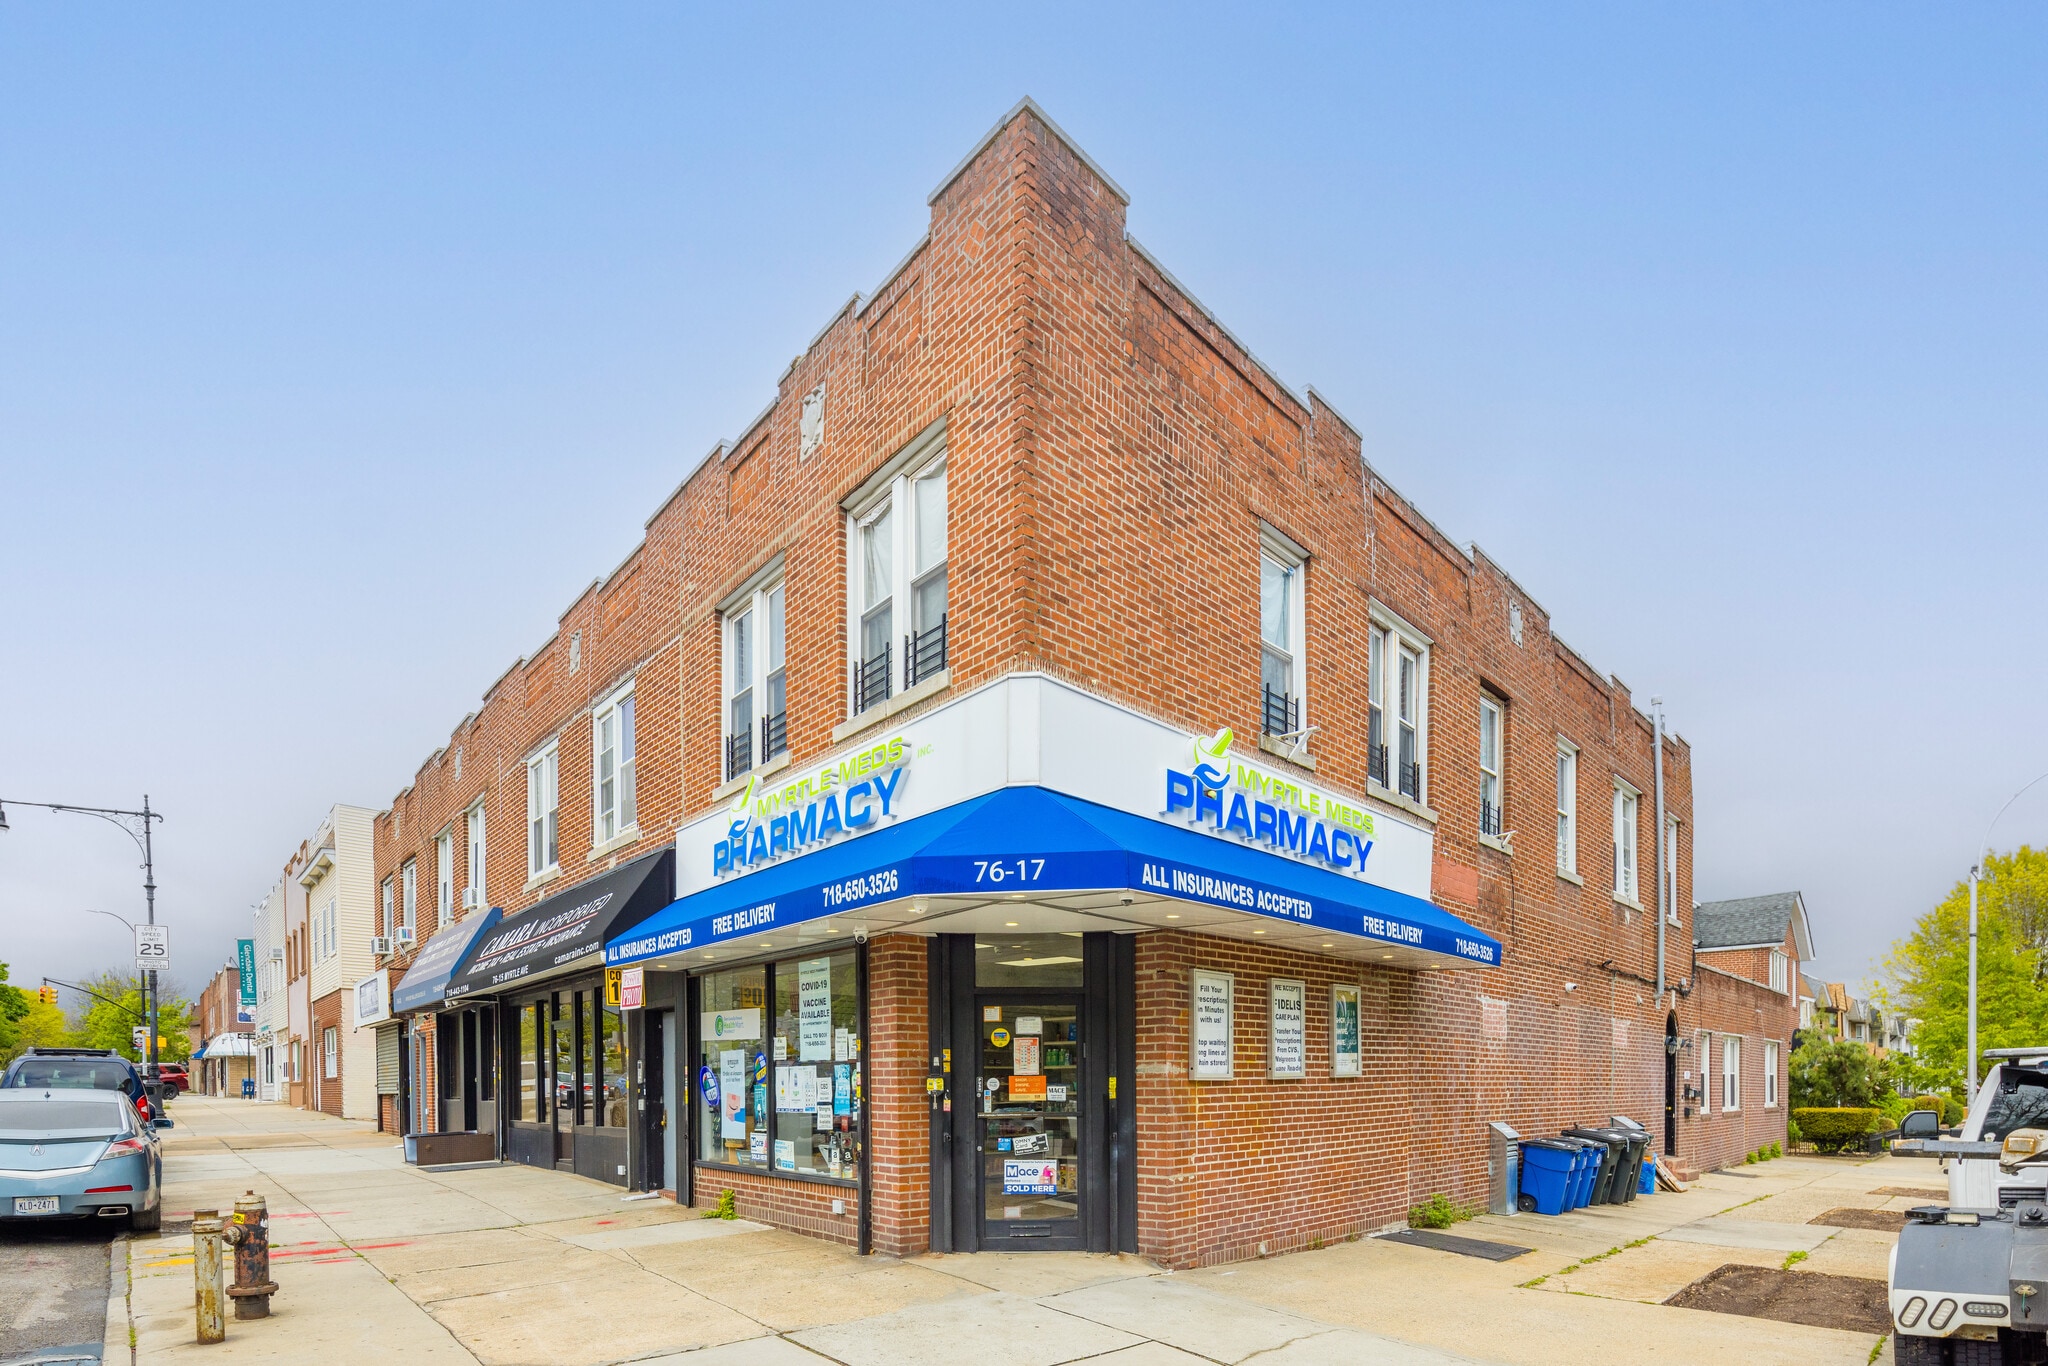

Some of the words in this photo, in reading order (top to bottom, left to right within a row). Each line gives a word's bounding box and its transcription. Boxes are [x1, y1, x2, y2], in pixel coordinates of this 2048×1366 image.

[757, 768, 832, 819] MYRTLE
[838, 737, 903, 784] MEDS
[917, 744, 934, 759] INC.
[1237, 765, 1320, 815] MYRTLE
[1326, 799, 1374, 835] MEDS
[713, 767, 903, 877] PHARMACY
[1166, 768, 1374, 873] PHARMACY
[974, 859, 1045, 882] 76-17
[822, 869, 898, 908] 718-650-3526
[1142, 863, 1169, 889] ALL
[1172, 869, 1254, 907] INSURANCES
[1256, 889, 1312, 920] ACCEPTED
[480, 919, 540, 958] CAMARA
[532, 892, 613, 937] INCORPORATED
[713, 914, 733, 936] FREE
[734, 902, 776, 931] DELIVERY
[1363, 915, 1385, 935] FREE
[1386, 920, 1423, 944] DELIVERY
[140, 943, 165, 956] 25
[554, 941, 599, 964] camarainc.com
[608, 946, 619, 962] ALL
[619, 937, 657, 959] INSURANCES
[657, 927, 692, 951] ACCEPTED
[1455, 938, 1494, 962] 718-650-3526
[244, 944, 253, 972] Glendale
[246, 972, 254, 994] Dental
[504, 967, 520, 981] MYRTLE
[520, 964, 529, 976] AVE
[801, 979, 828, 991] COVID-19
[1200, 984, 1210, 992] Fill
[1283, 984, 1299, 992] ACCEPT
[623, 987, 641, 1006] PHOTO
[803, 997, 827, 1008] VACCINE
[801, 1008, 830, 1019] AVAILABLE
[1200, 1015, 1212, 1023] with
[1204, 1005, 1225, 1014] Minutes
[1199, 1039, 1208, 1047] top
[1208, 1039, 1227, 1047] waiting
[1015, 1137, 1032, 1145] OMNY
[1006, 1165, 1039, 1177] Mace
[1031, 1185, 1055, 1193] HERE
